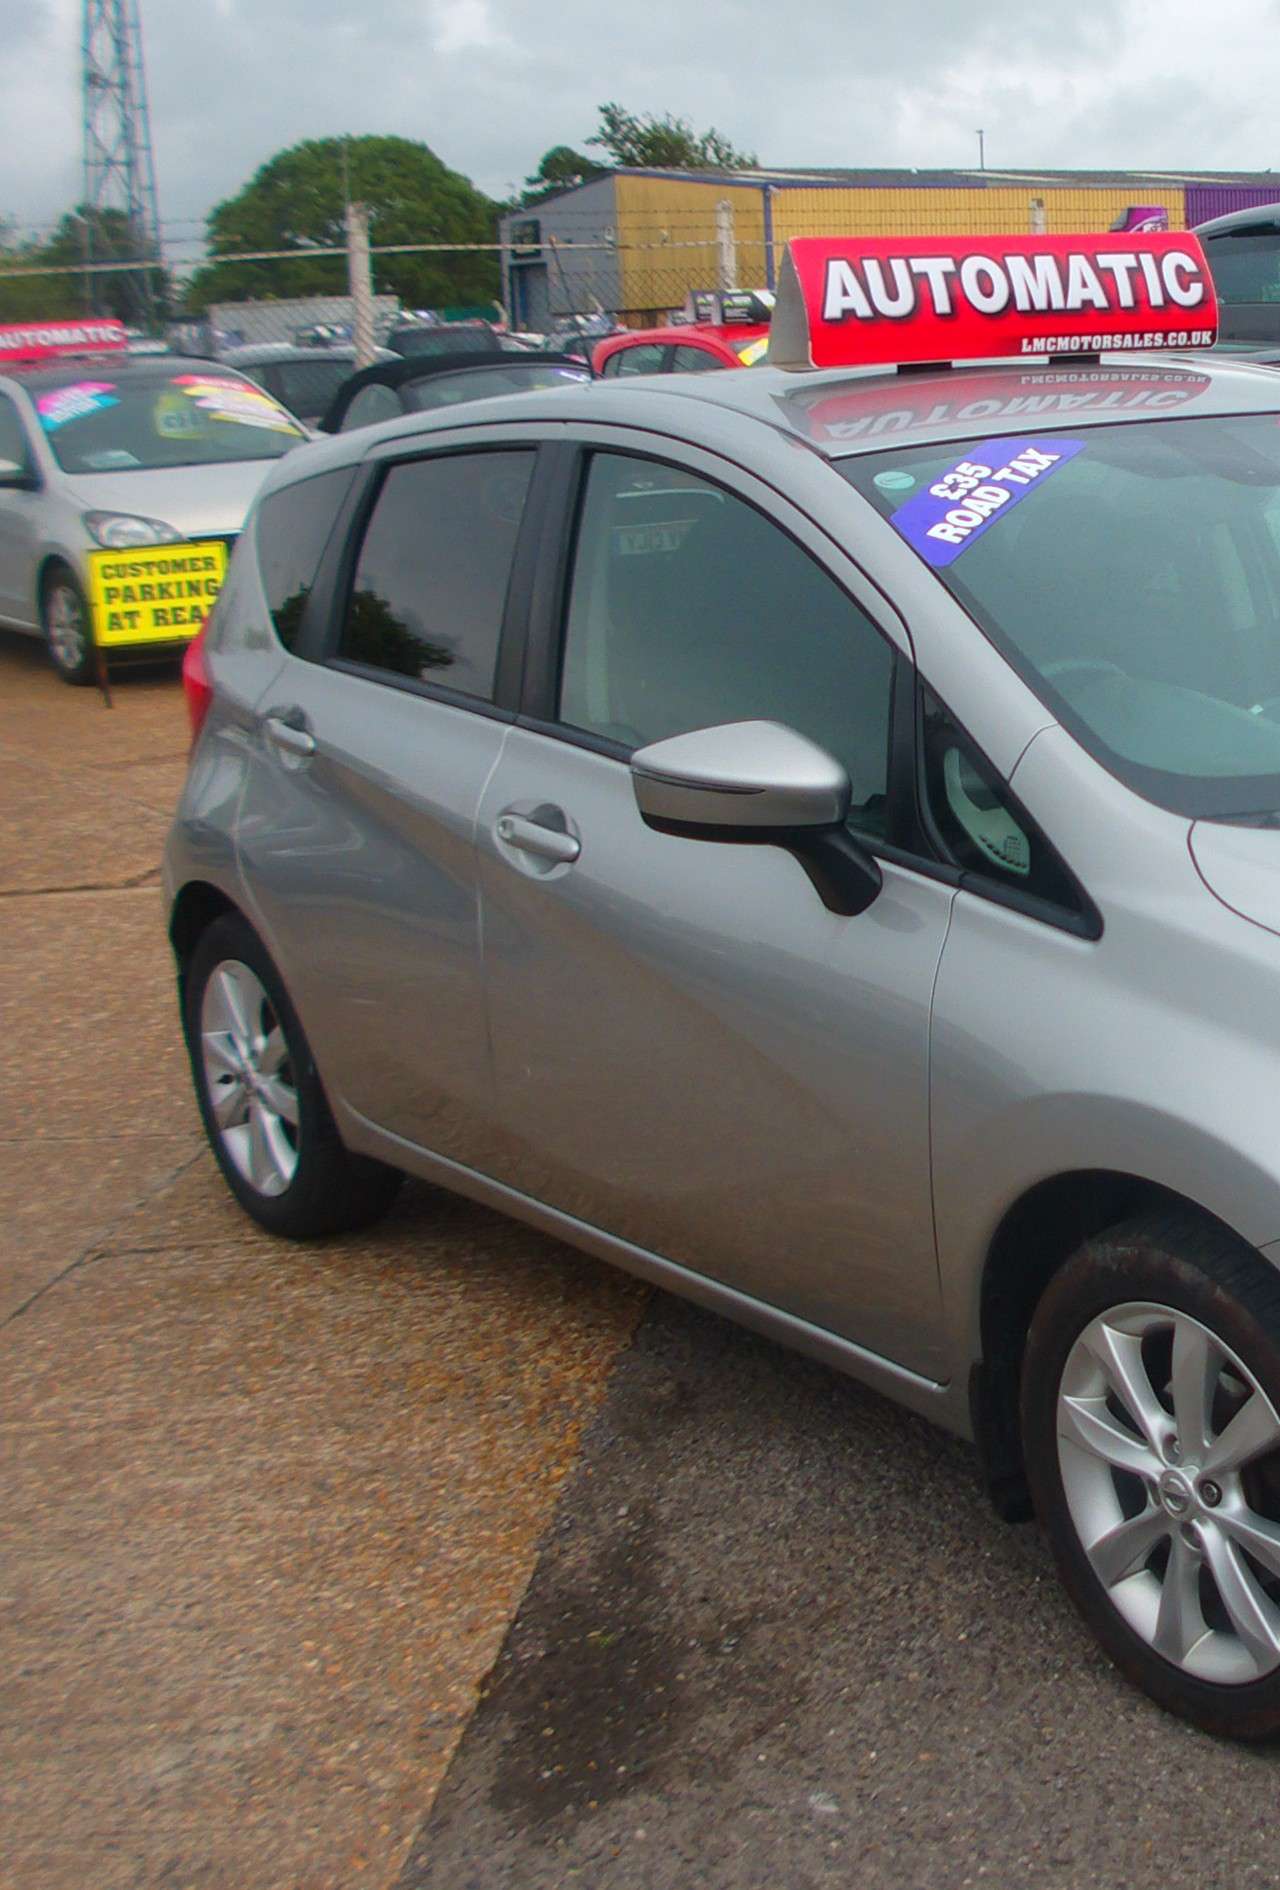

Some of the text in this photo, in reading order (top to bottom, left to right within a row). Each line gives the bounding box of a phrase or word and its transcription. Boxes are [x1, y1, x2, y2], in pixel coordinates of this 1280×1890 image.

[823, 251, 1204, 321] AUTOMATIC
[1021, 331, 1212, 353] LMCMOTORSALES.CO.UK
[929, 462, 992, 501] £35
[926, 448, 1061, 544] ROAD TAX
[101, 556, 216, 580] CUSTOMER
[104, 578, 219, 604] PARKING
[108, 604, 212, 631] AT REA
